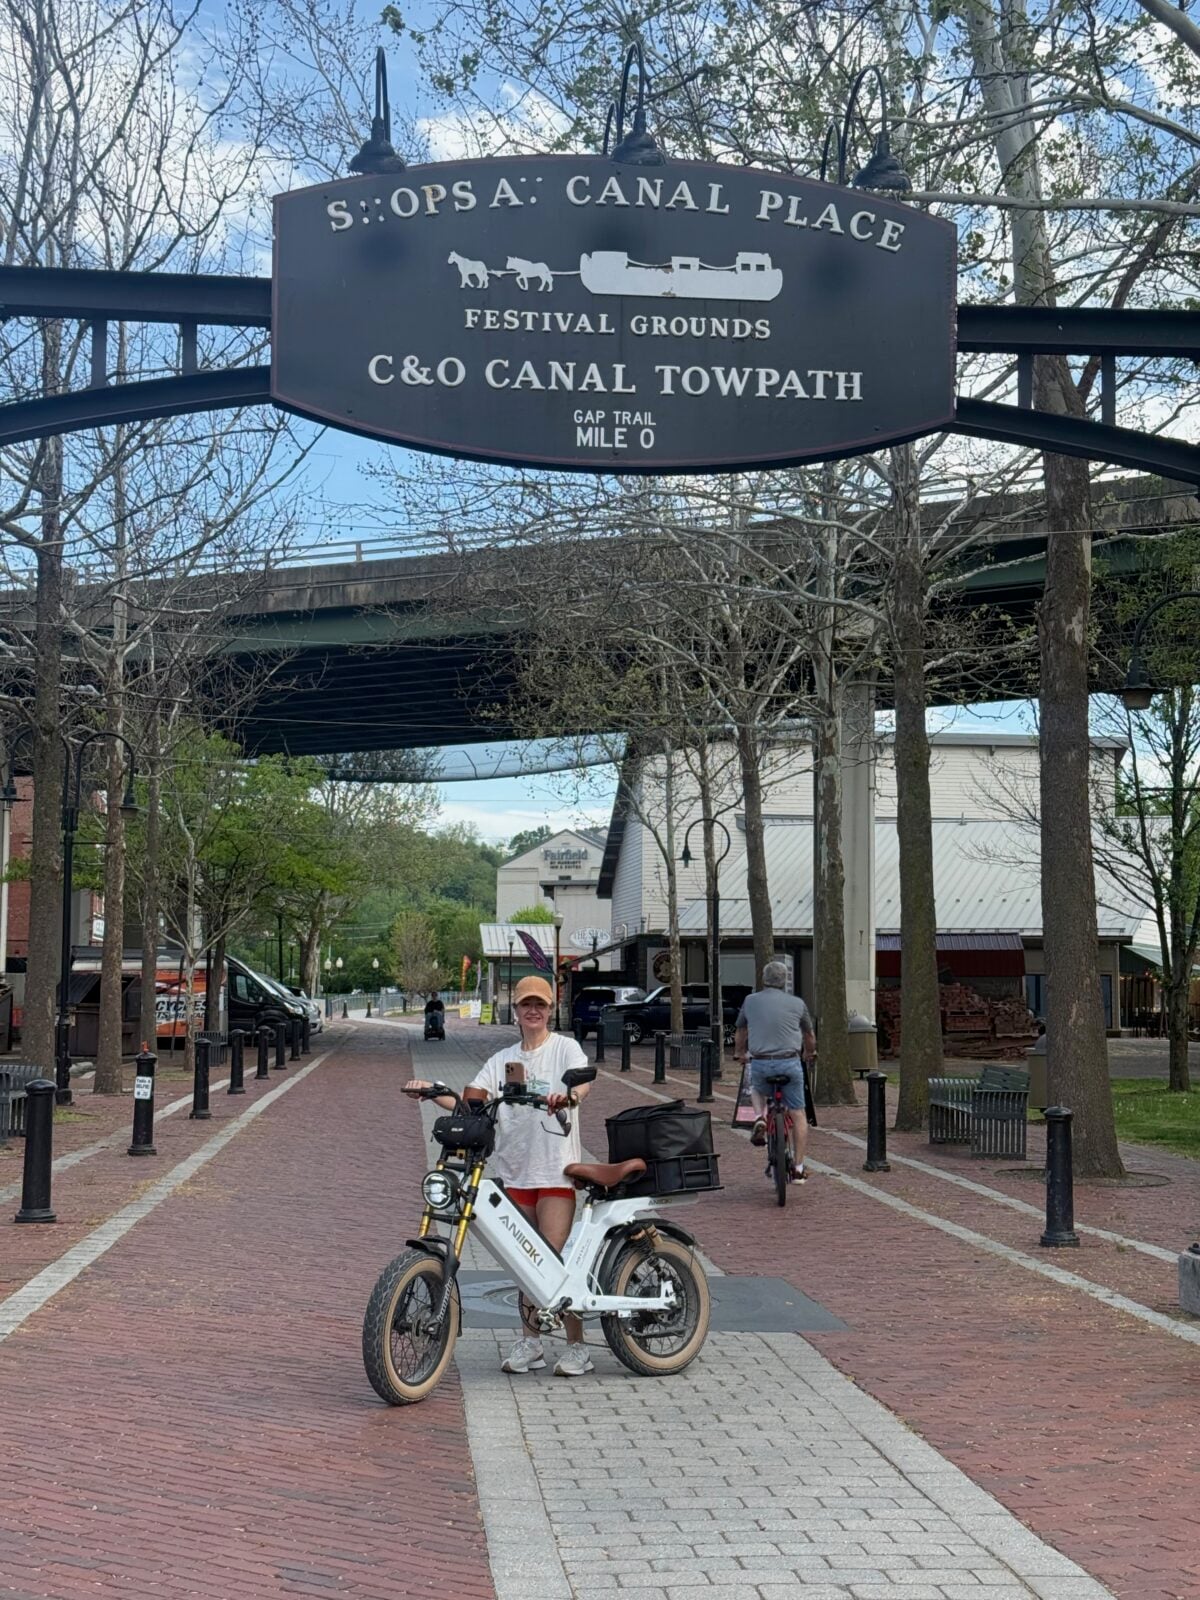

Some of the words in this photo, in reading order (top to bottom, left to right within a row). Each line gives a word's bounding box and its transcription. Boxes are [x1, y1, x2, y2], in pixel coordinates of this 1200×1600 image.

[327, 180, 477, 232] SOPS
[489, 177, 543, 208] A
[566, 175, 731, 215] CANAL
[755, 190, 905, 252] PLACE
[464, 308, 615, 334] FESTIVAL
[630, 314, 771, 339] GROUNDS
[368, 355, 467, 387] C&O
[485, 359, 636, 394] CANAL
[655, 364, 864, 401] TOWPATH
[573, 409, 606, 424] GAP
[613, 410, 657, 426] TRAIL
[576, 427, 628, 449] MILE
[544, 849, 588, 861] Fairfield
[498, 1215, 544, 1267] ANIIOKI
